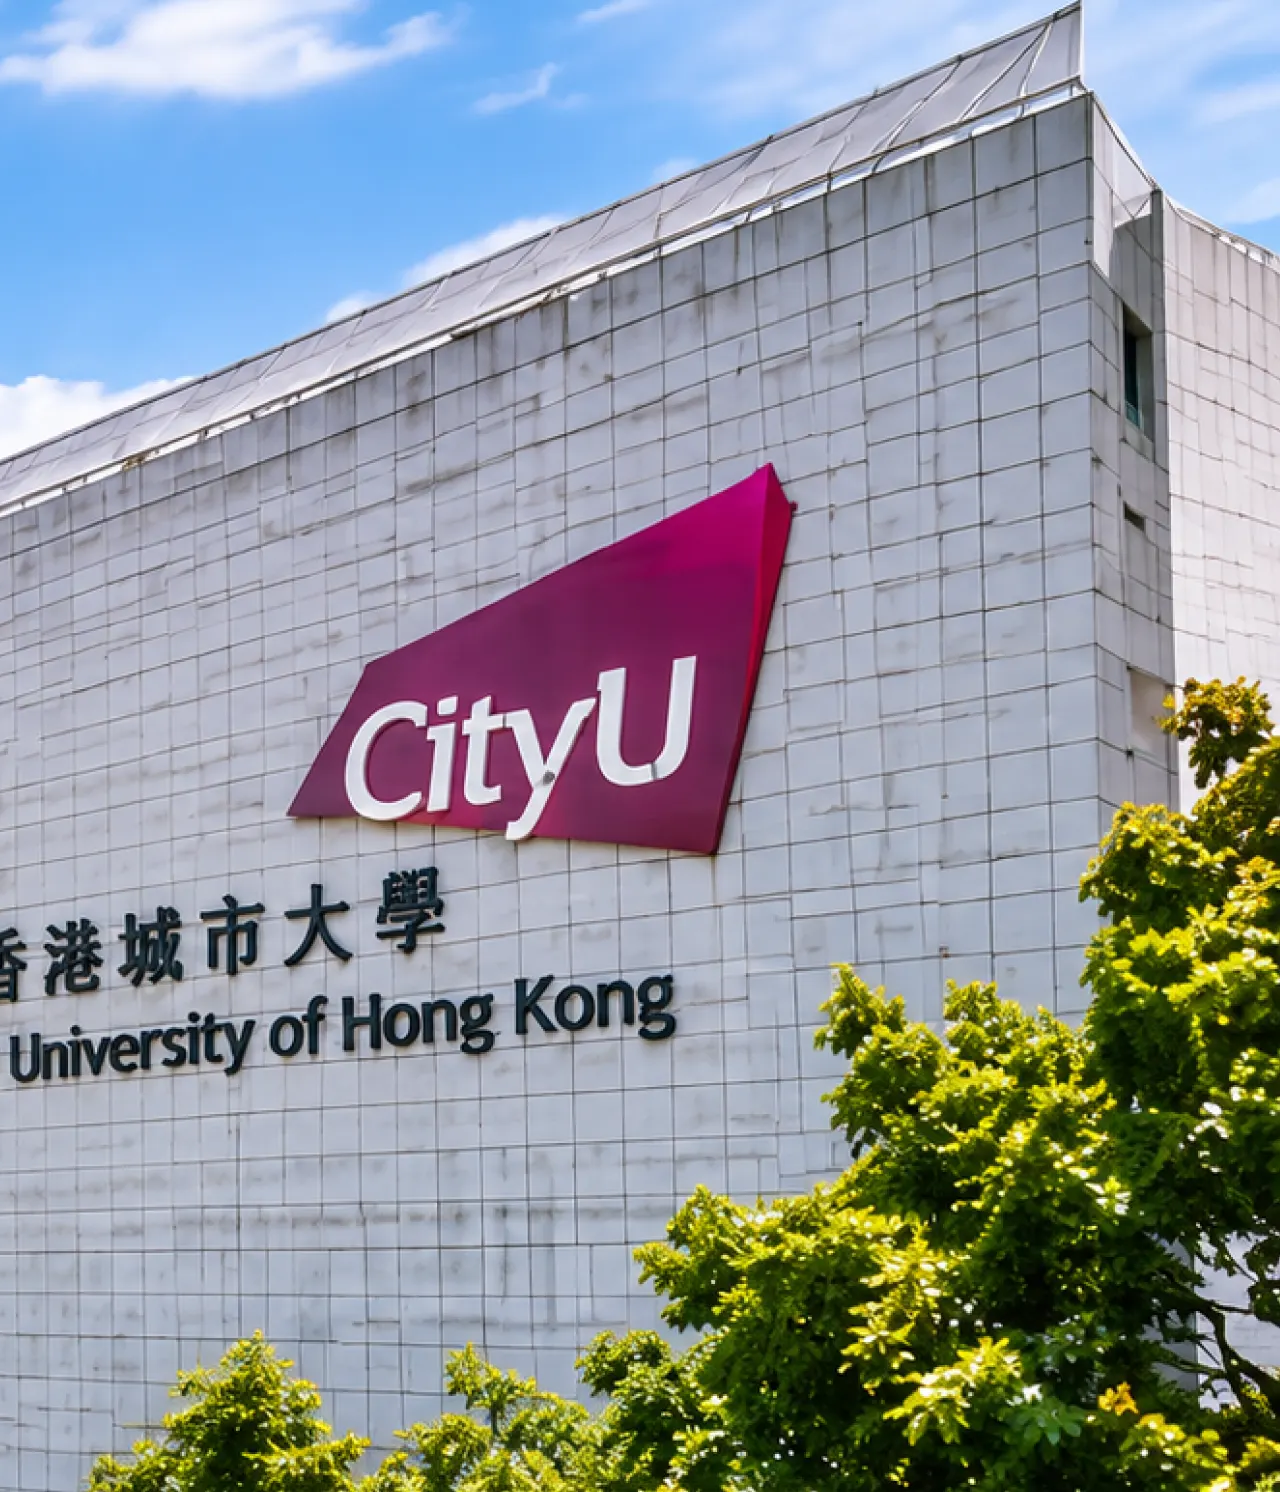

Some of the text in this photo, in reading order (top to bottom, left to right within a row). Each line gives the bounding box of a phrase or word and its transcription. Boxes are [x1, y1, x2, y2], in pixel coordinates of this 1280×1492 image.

[344, 655, 697, 841] CityU
[9, 1011, 256, 1083] University
[268, 995, 329, 1059] of
[340, 992, 496, 1056] Hong
[512, 973, 678, 1043] Kong
